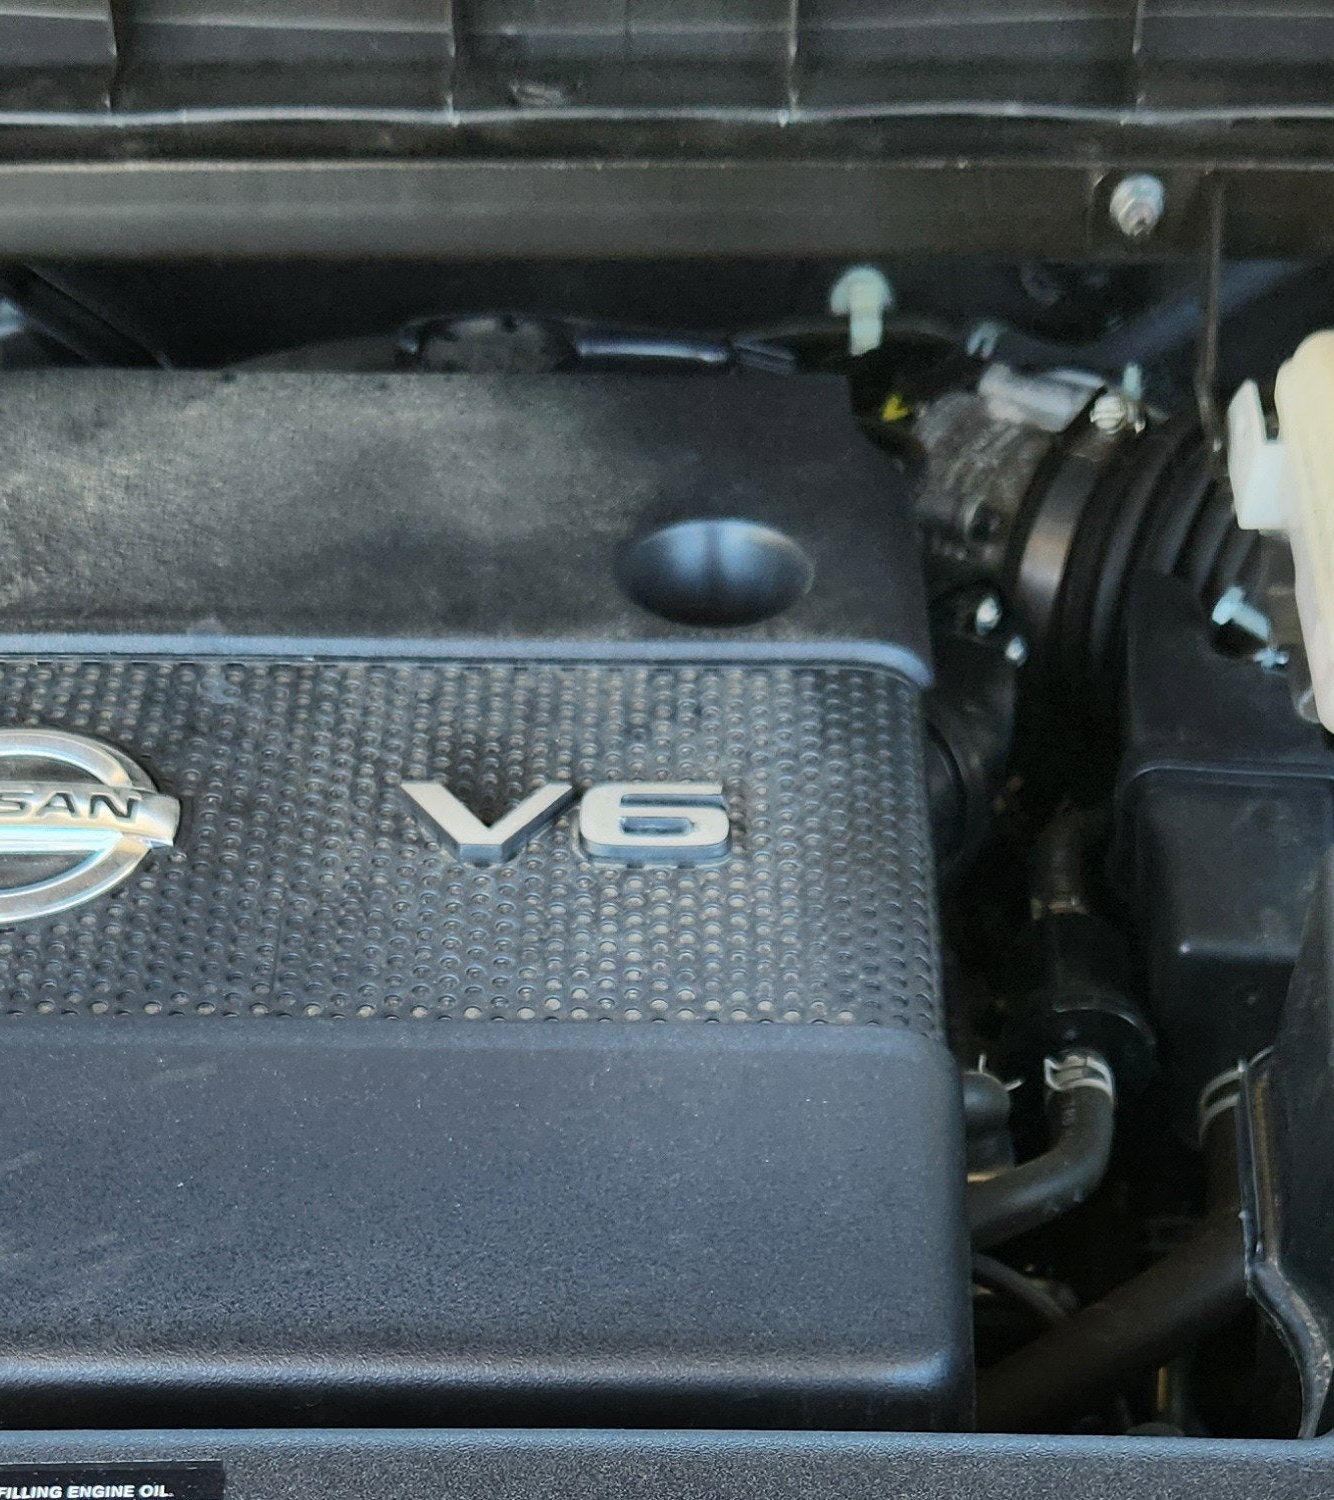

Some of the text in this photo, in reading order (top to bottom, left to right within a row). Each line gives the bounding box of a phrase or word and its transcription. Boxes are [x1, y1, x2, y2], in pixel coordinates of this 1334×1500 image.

[400, 781, 731, 862] V6
[67, 1485, 135, 1499] ENGINE
[139, 1484, 175, 1498] OIL.
